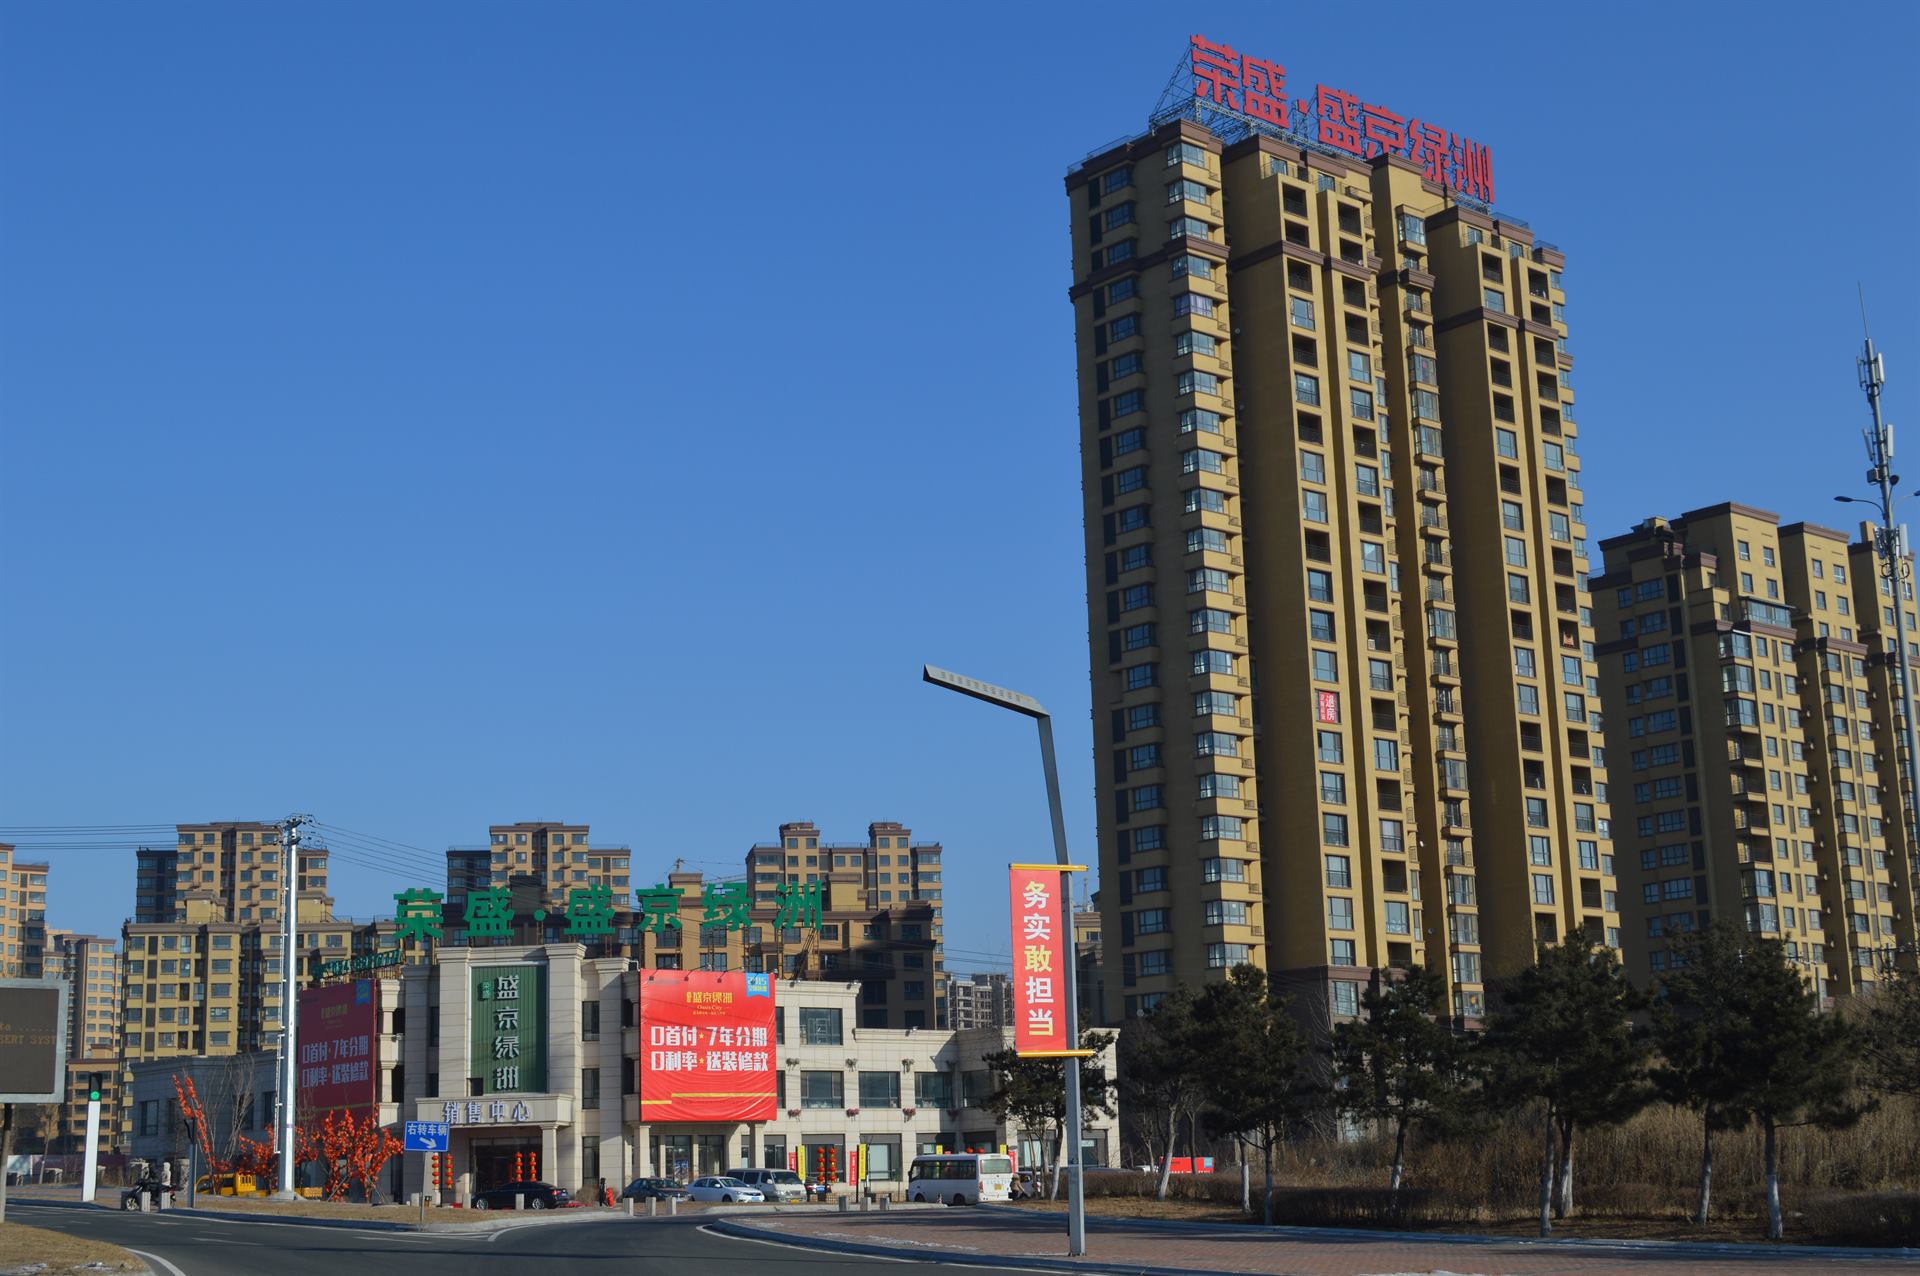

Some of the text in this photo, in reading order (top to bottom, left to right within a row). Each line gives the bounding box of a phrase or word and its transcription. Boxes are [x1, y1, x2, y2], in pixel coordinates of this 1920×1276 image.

[393, 882, 822, 941] 荣盛·盛京绿洲
[1022, 880, 1054, 1036] 务实敢担当
[495, 974, 520, 1089] 盛京绿洲
[706, 1026, 768, 1047] 7年分期
[706, 1051, 769, 1072] 送装修款
[443, 1100, 531, 1124] 销售中心
[407, 1123, 448, 1137] 右转车辆
